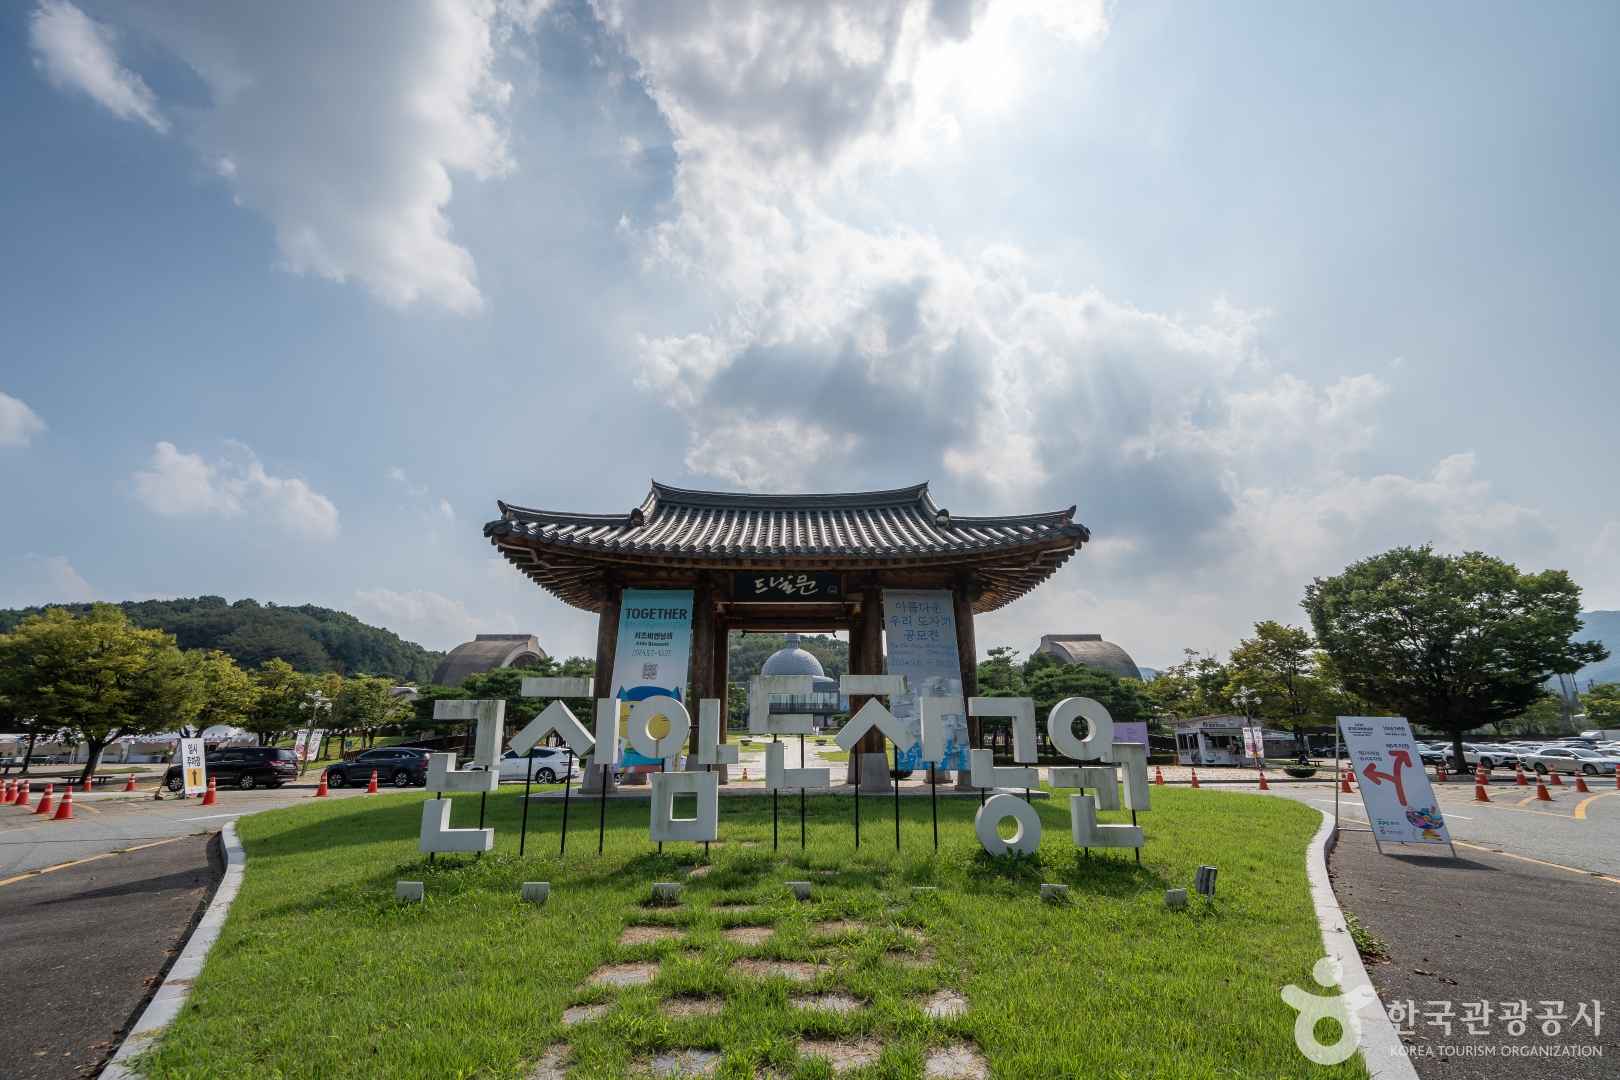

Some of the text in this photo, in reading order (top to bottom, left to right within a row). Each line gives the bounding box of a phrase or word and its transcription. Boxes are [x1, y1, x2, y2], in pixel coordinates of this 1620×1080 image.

[624, 608, 688, 620] TOGETHER
[889, 615, 913, 627] 우리
[420, 675, 1152, 856] 곤지암도자공원
